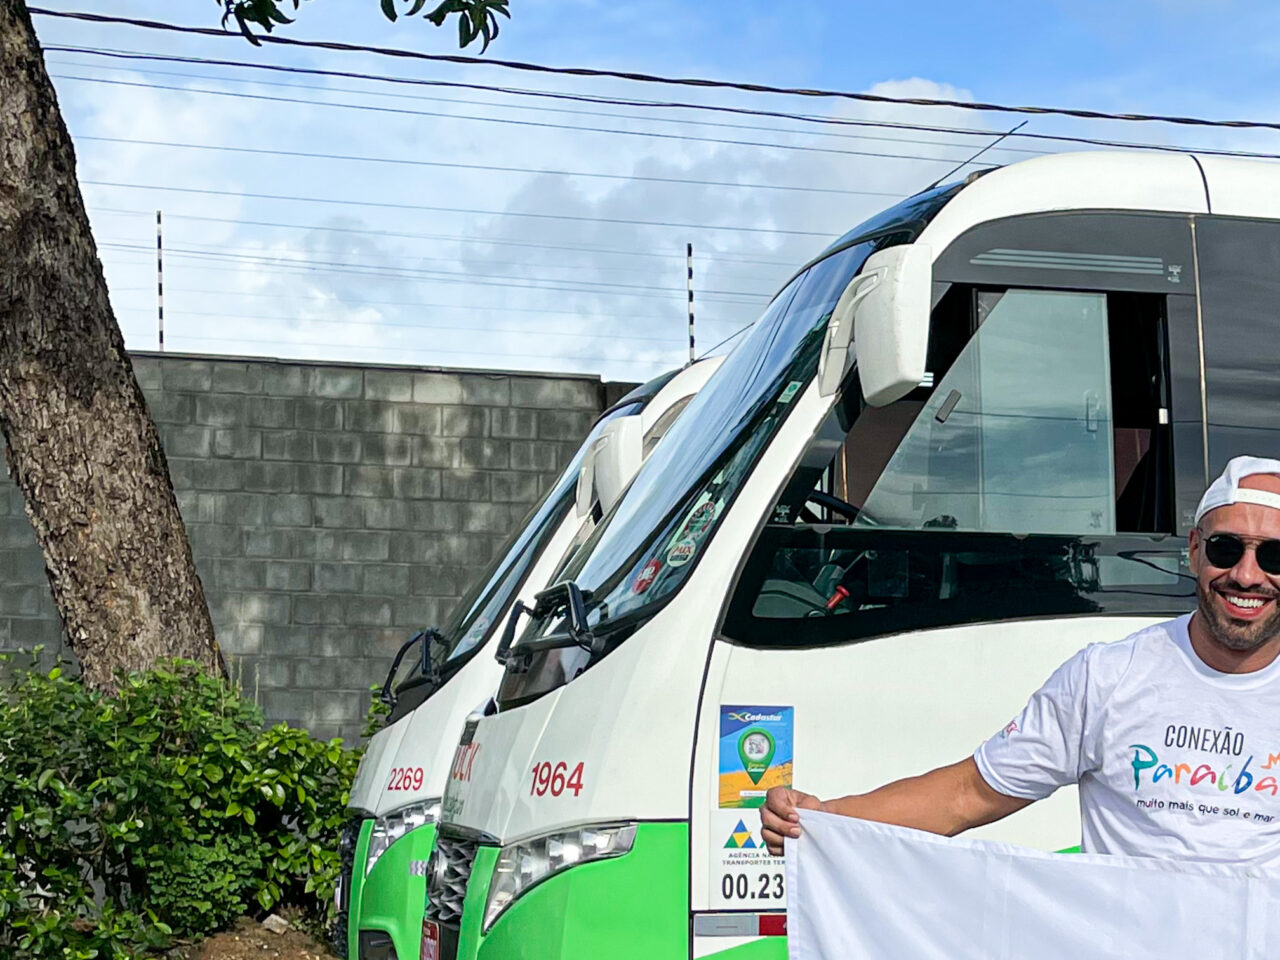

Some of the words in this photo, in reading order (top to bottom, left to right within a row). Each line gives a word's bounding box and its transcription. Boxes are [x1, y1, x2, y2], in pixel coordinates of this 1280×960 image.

[1164, 724, 1245, 756] CONEXÃO
[387, 767, 424, 791] 2269
[530, 761, 584, 797] 1964
[1128, 744, 1279, 796] Paraíba
[1136, 798, 1165, 809] muito
[1168, 801, 1194, 811] mais
[1199, 803, 1219, 816] que
[1223, 807, 1240, 817] sol
[1243, 811, 1251, 819] e
[1253, 812, 1276, 823] mar
